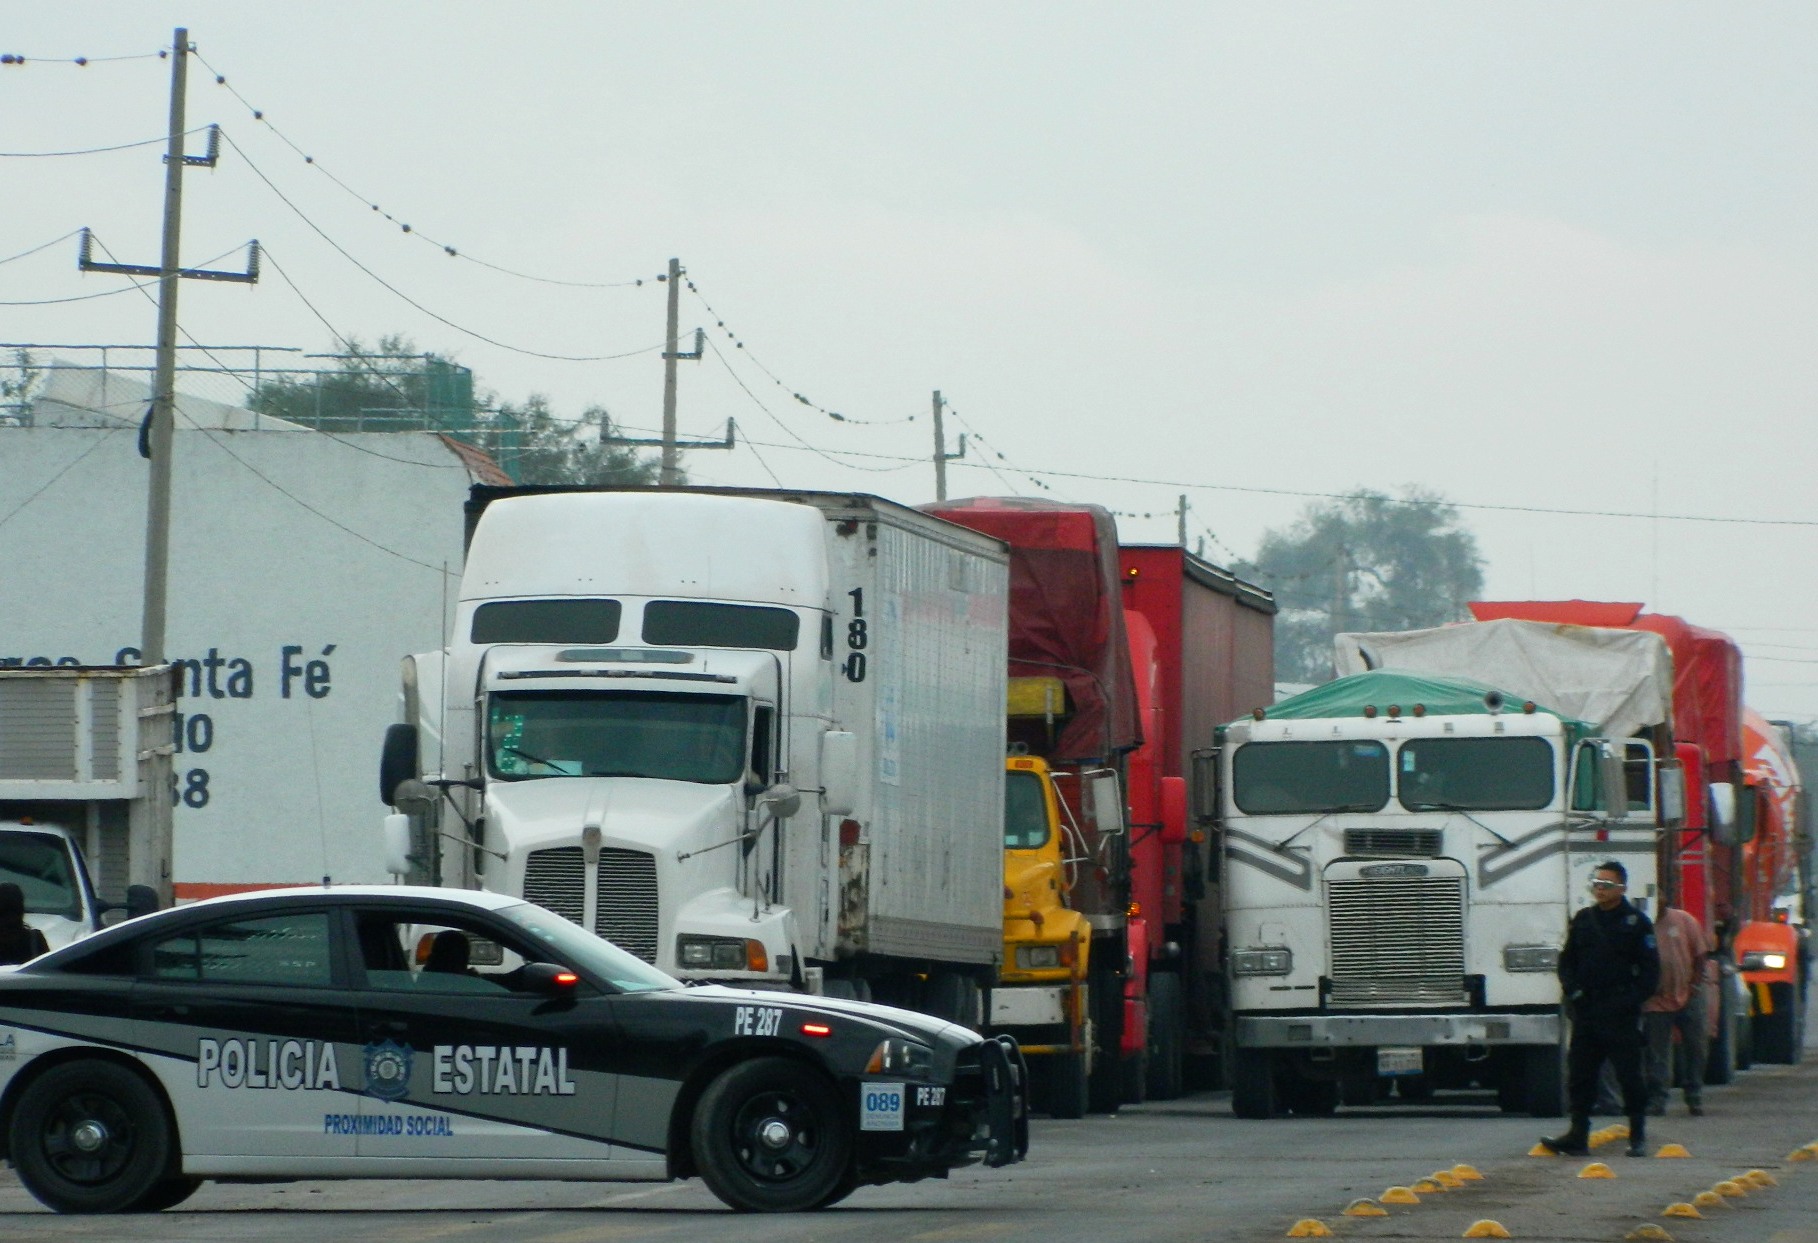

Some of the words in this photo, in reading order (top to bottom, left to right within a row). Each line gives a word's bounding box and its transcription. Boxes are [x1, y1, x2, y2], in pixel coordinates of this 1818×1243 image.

[846, 587, 867, 683] 180
[281, 644, 337, 699] Fé
[735, 1006, 755, 1035] PE
[756, 1008, 783, 1036] 287
[197, 1037, 341, 1091] POLICIA
[432, 1044, 576, 1096] ESTATAL
[866, 1092, 901, 1112] 089
[916, 1087, 929, 1106] PE
[324, 1113, 404, 1136] PROXIMIDAD
[406, 1115, 453, 1137] SOCIAL
